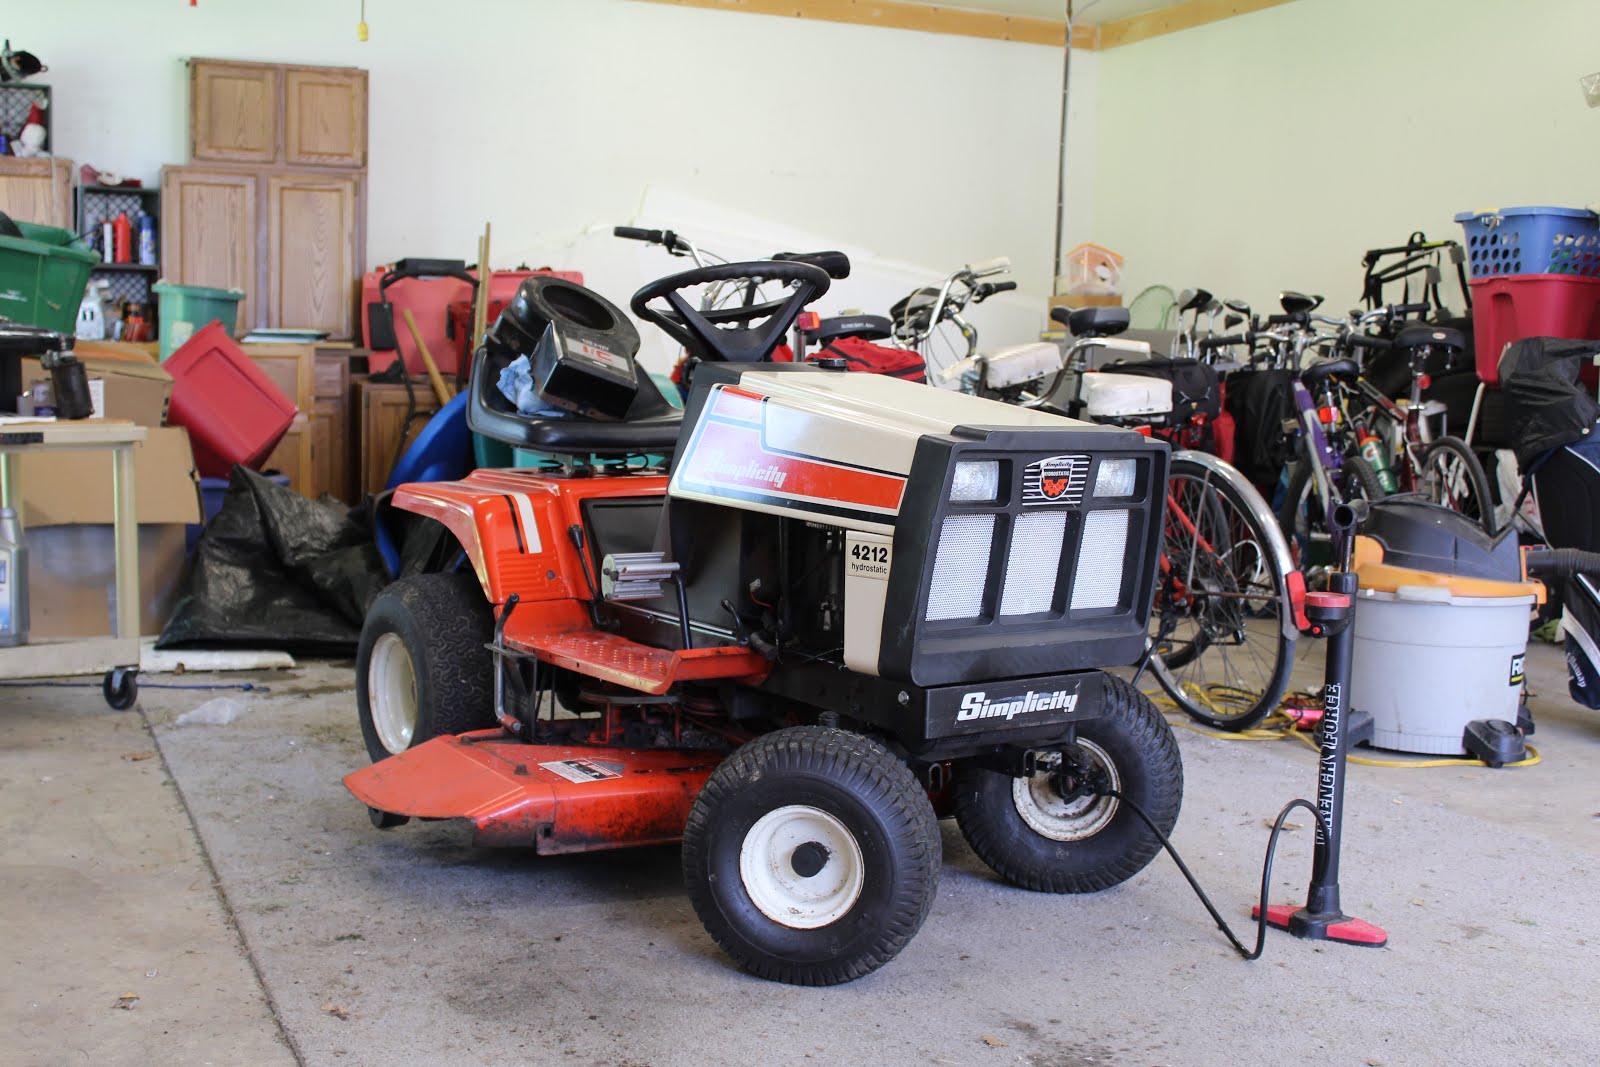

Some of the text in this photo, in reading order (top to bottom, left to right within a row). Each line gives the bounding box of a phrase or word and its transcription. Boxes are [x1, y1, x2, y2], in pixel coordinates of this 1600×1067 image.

[851, 544, 888, 563] 4212
[851, 562, 888, 574] hydrostatic
[957, 690, 1078, 721] Simplicity
[1323, 683, 1341, 745] FORCE
